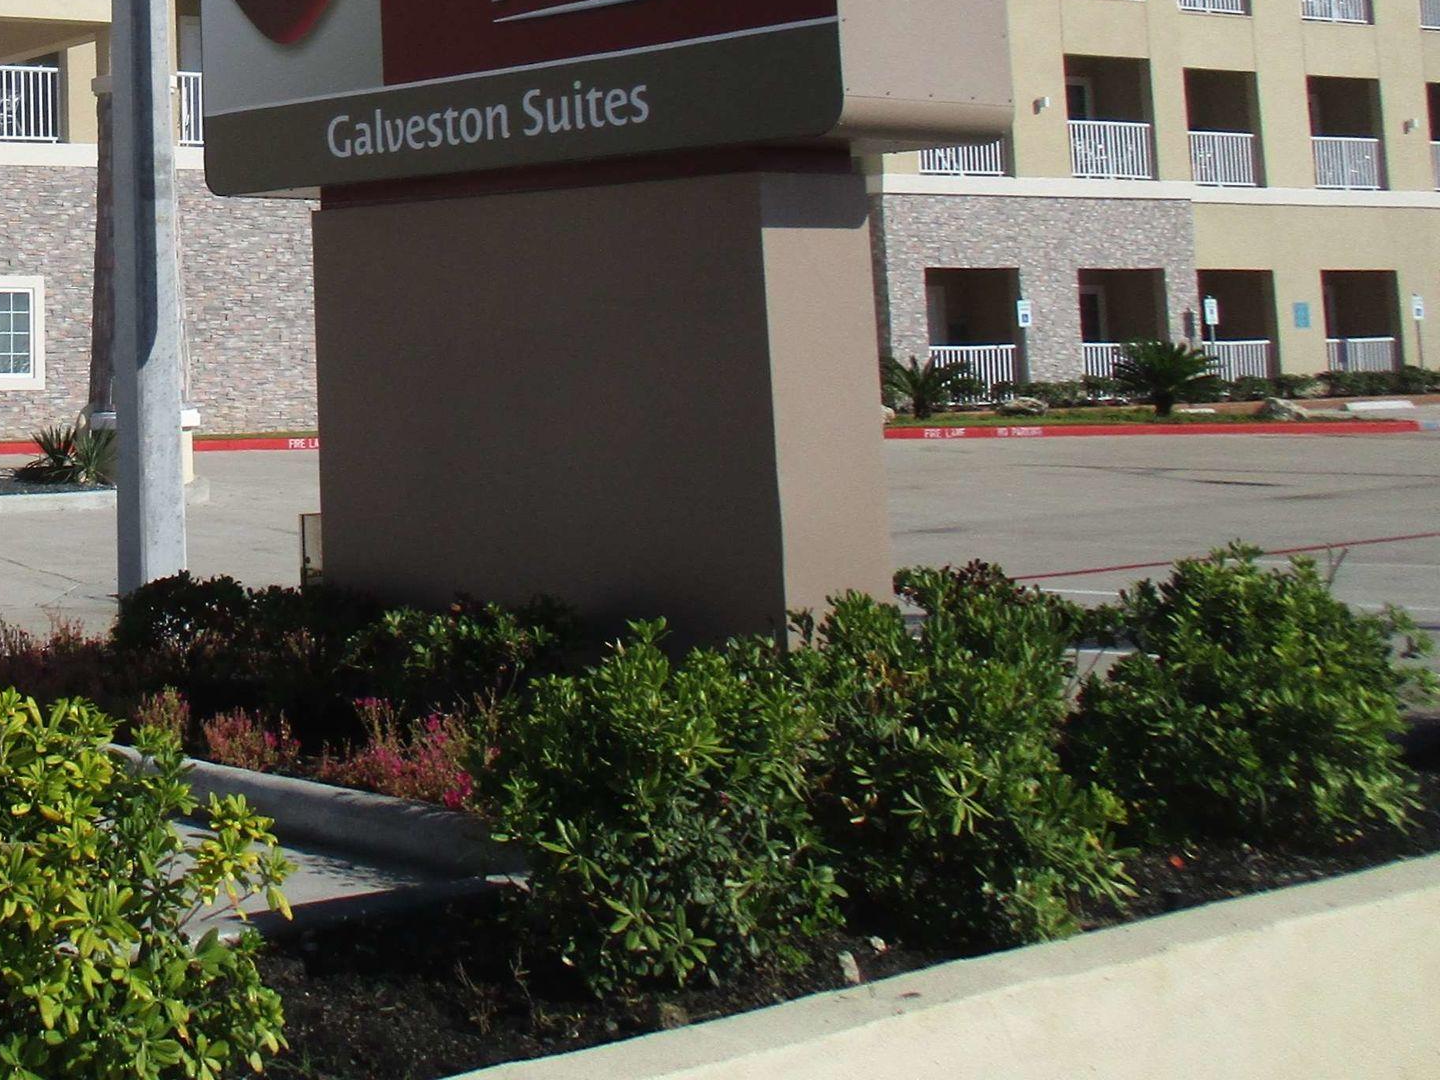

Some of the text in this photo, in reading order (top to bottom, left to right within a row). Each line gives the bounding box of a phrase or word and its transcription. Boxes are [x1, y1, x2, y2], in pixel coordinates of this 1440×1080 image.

[326, 80, 650, 159] Galveston Suites
[288, 438, 306, 448] FIRE
